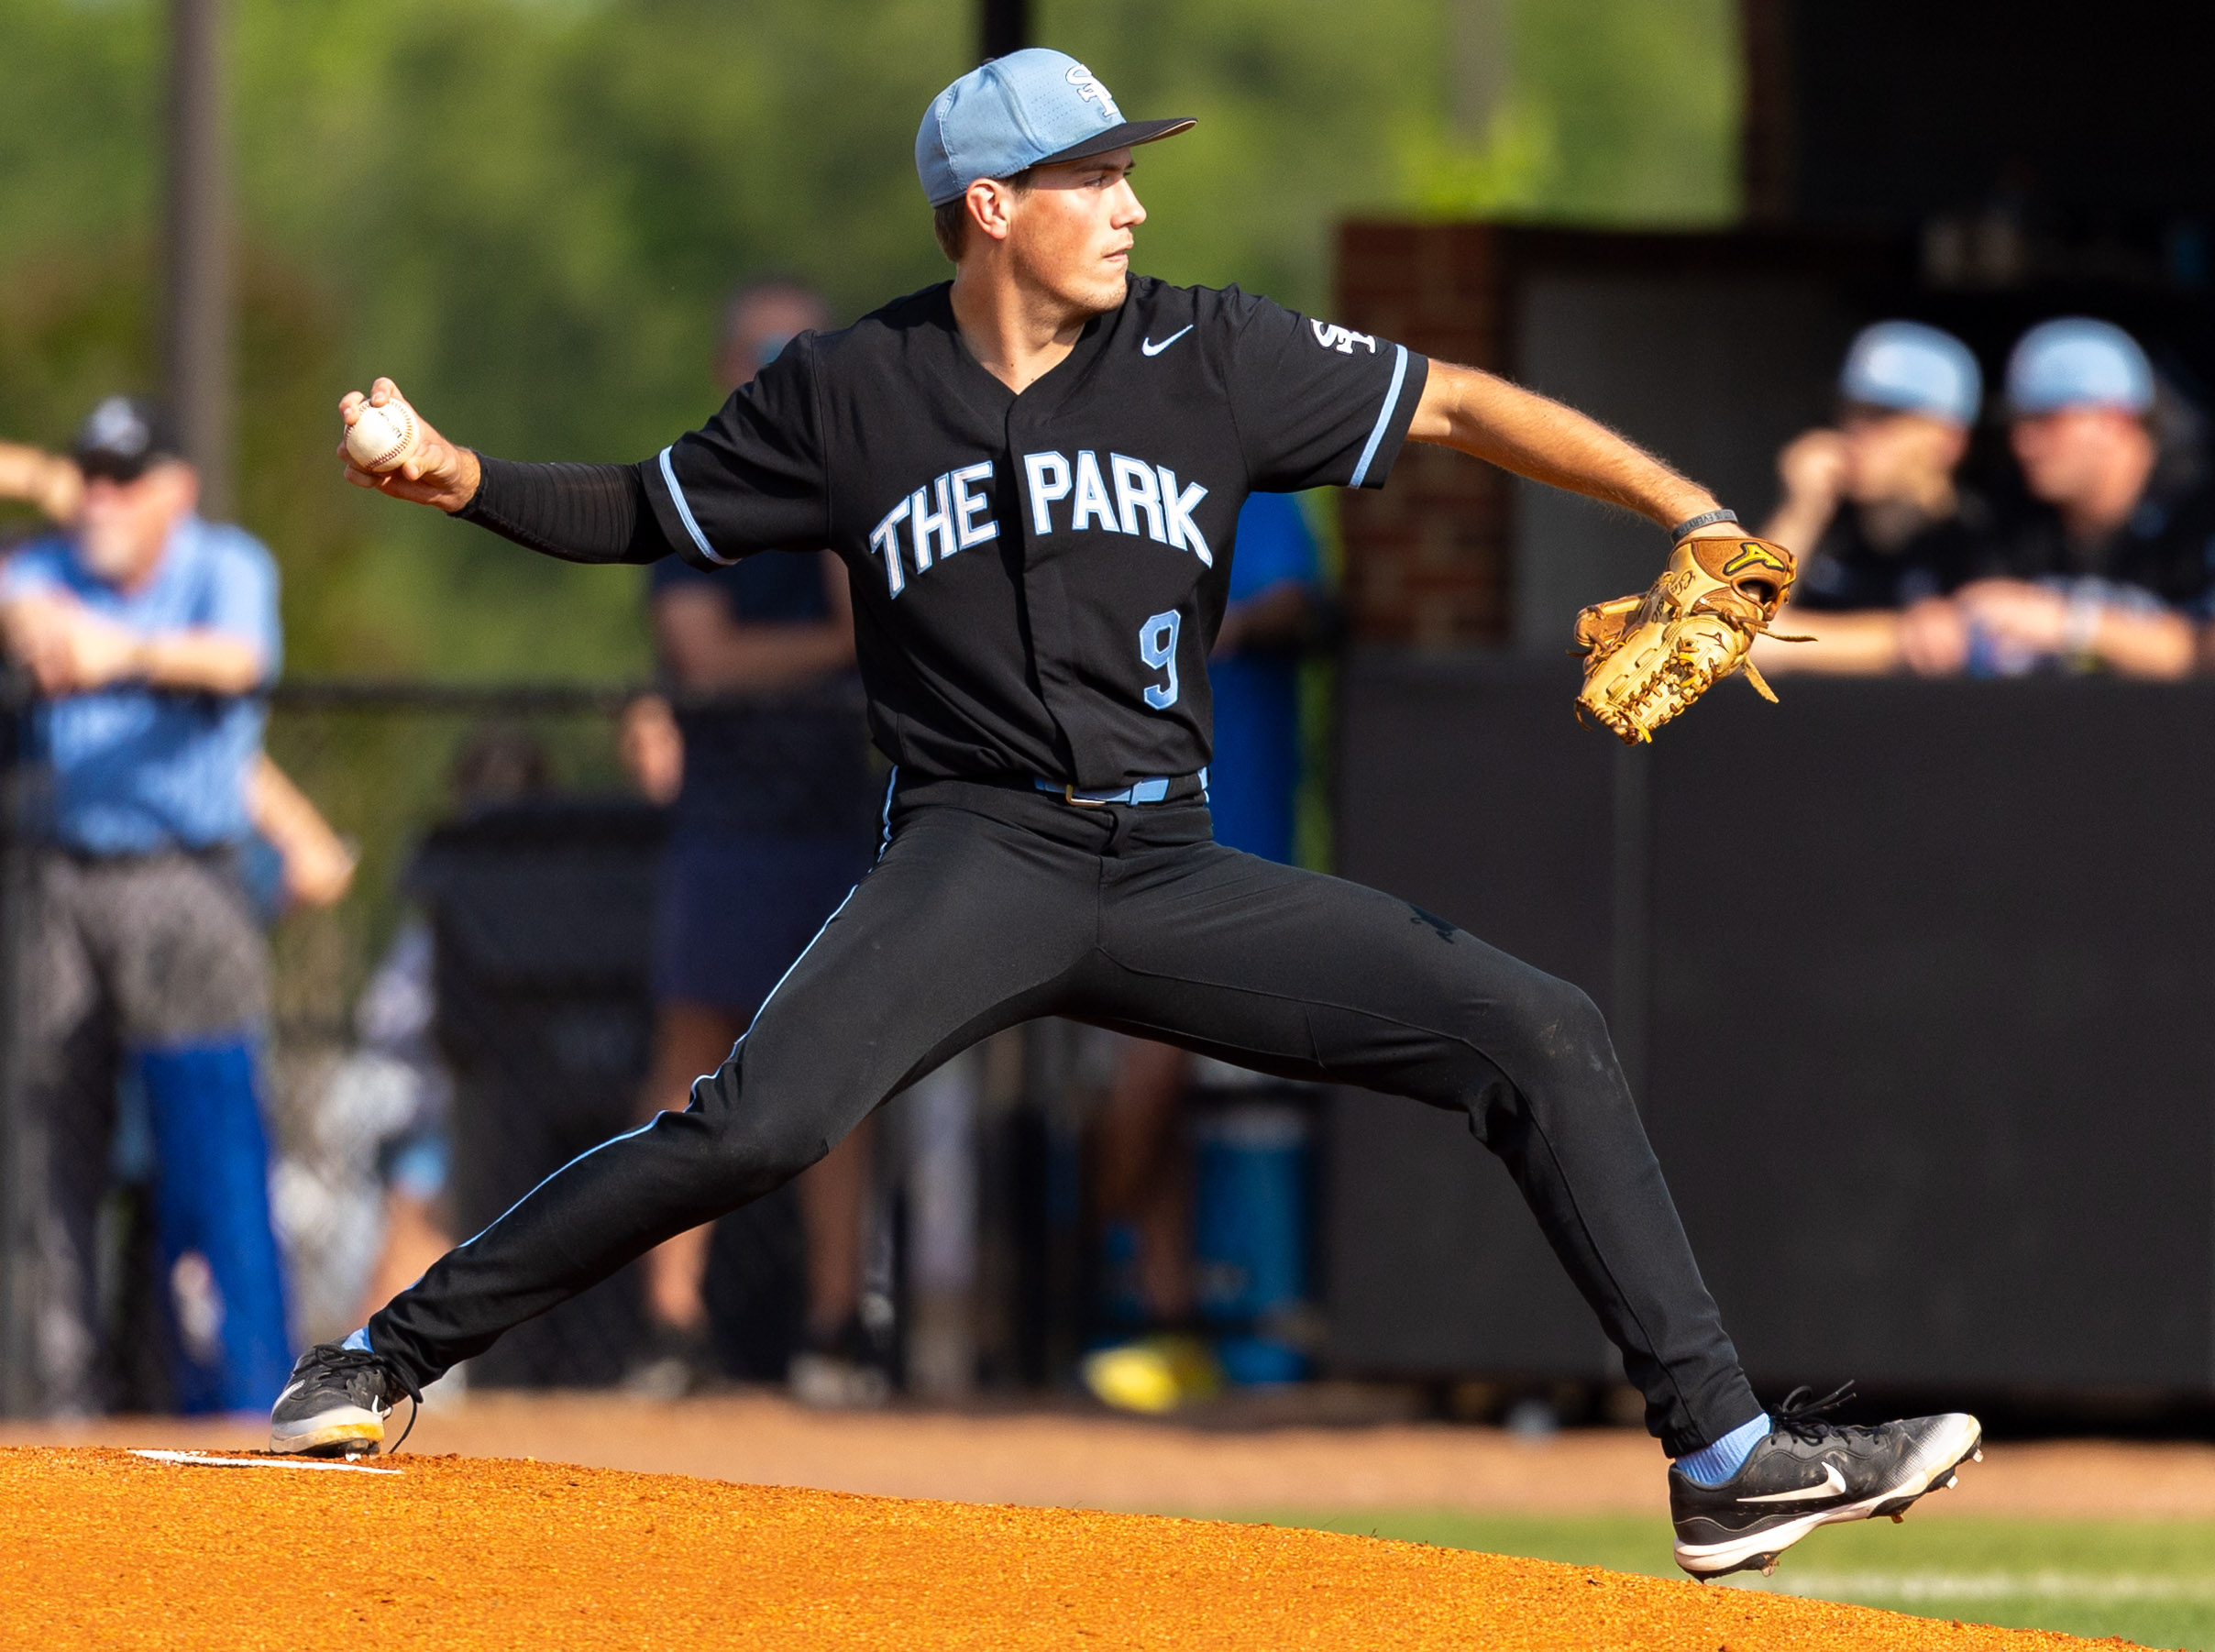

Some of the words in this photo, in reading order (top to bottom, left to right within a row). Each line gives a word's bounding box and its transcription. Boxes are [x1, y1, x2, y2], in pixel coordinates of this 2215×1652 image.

[869, 459, 999, 600] THE
[1023, 449, 1213, 569] PARK
[1139, 608, 1182, 710] 9
